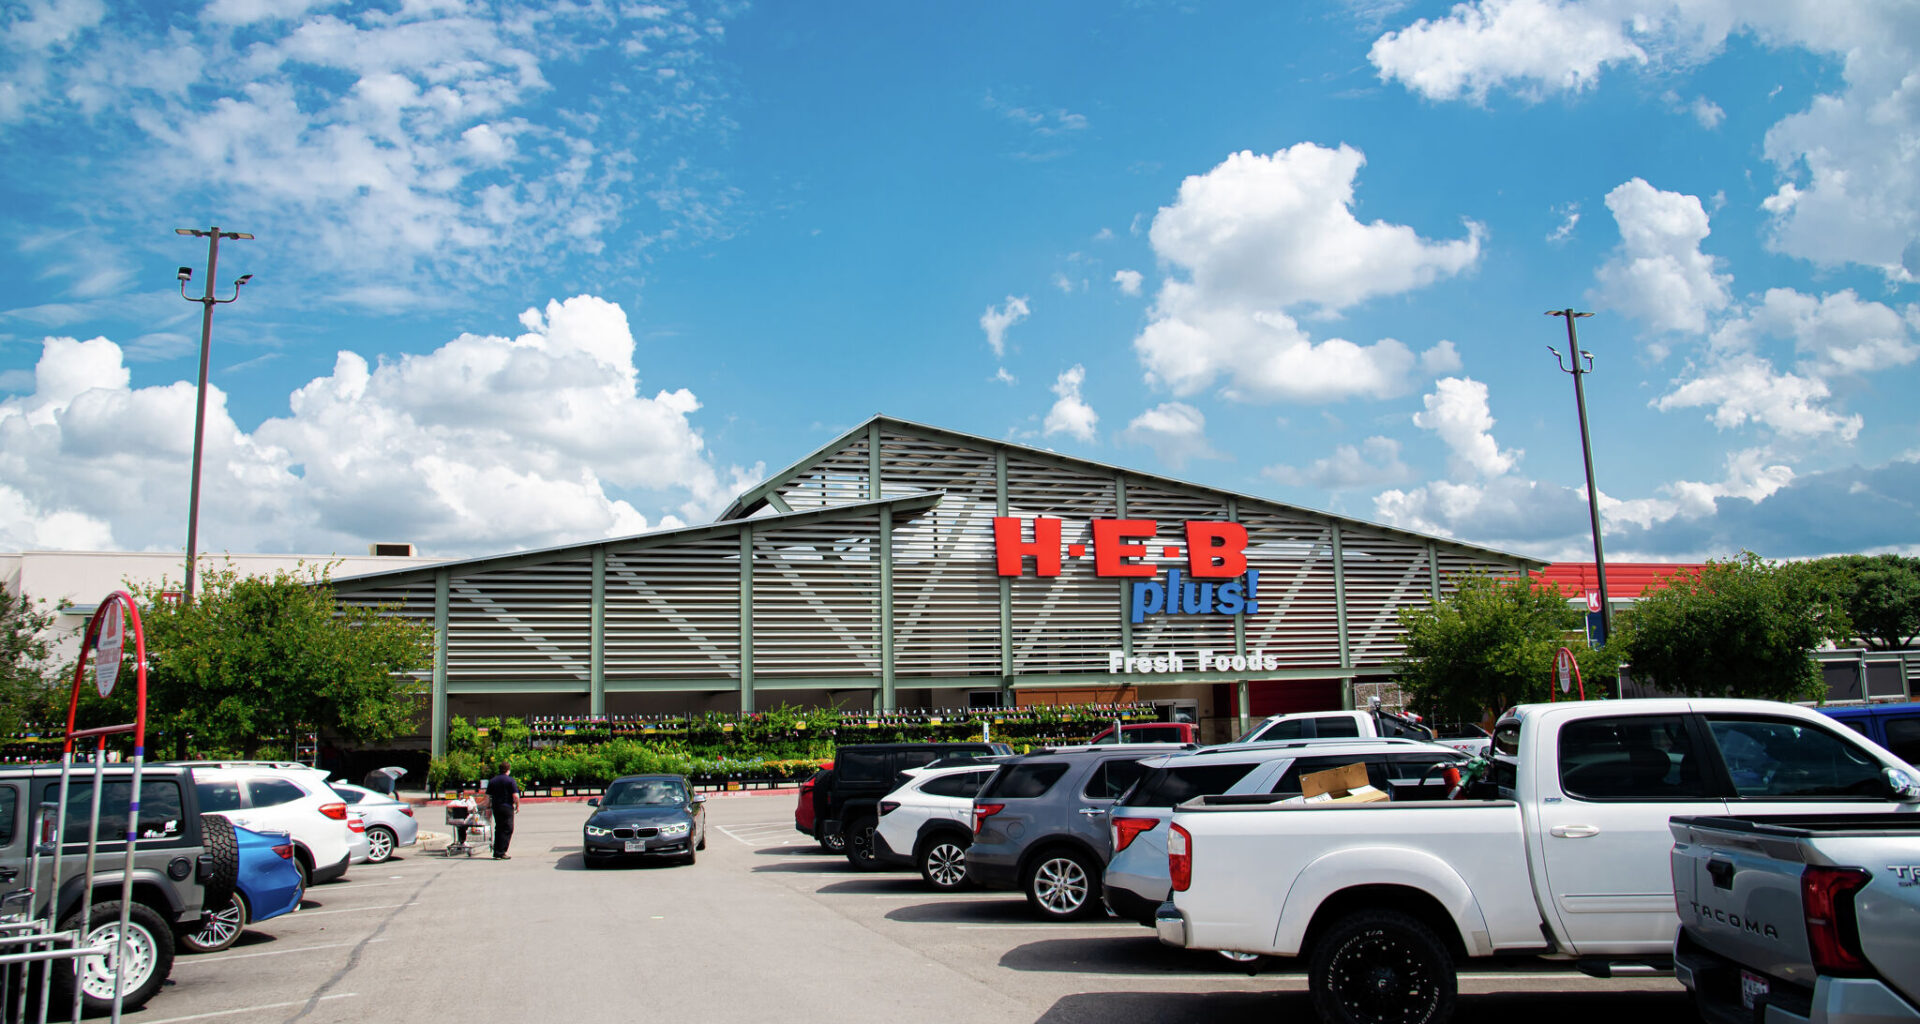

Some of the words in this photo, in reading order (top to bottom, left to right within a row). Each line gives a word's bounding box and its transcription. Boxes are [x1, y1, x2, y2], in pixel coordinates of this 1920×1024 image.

[993, 517, 1249, 578] H-E-B
[1131, 568, 1260, 623] plus!
[1589, 593, 1599, 607] K
[1108, 650, 1183, 674] Fresh
[1198, 650, 1278, 672] Foods
[1691, 901, 1779, 939] TACOMA
